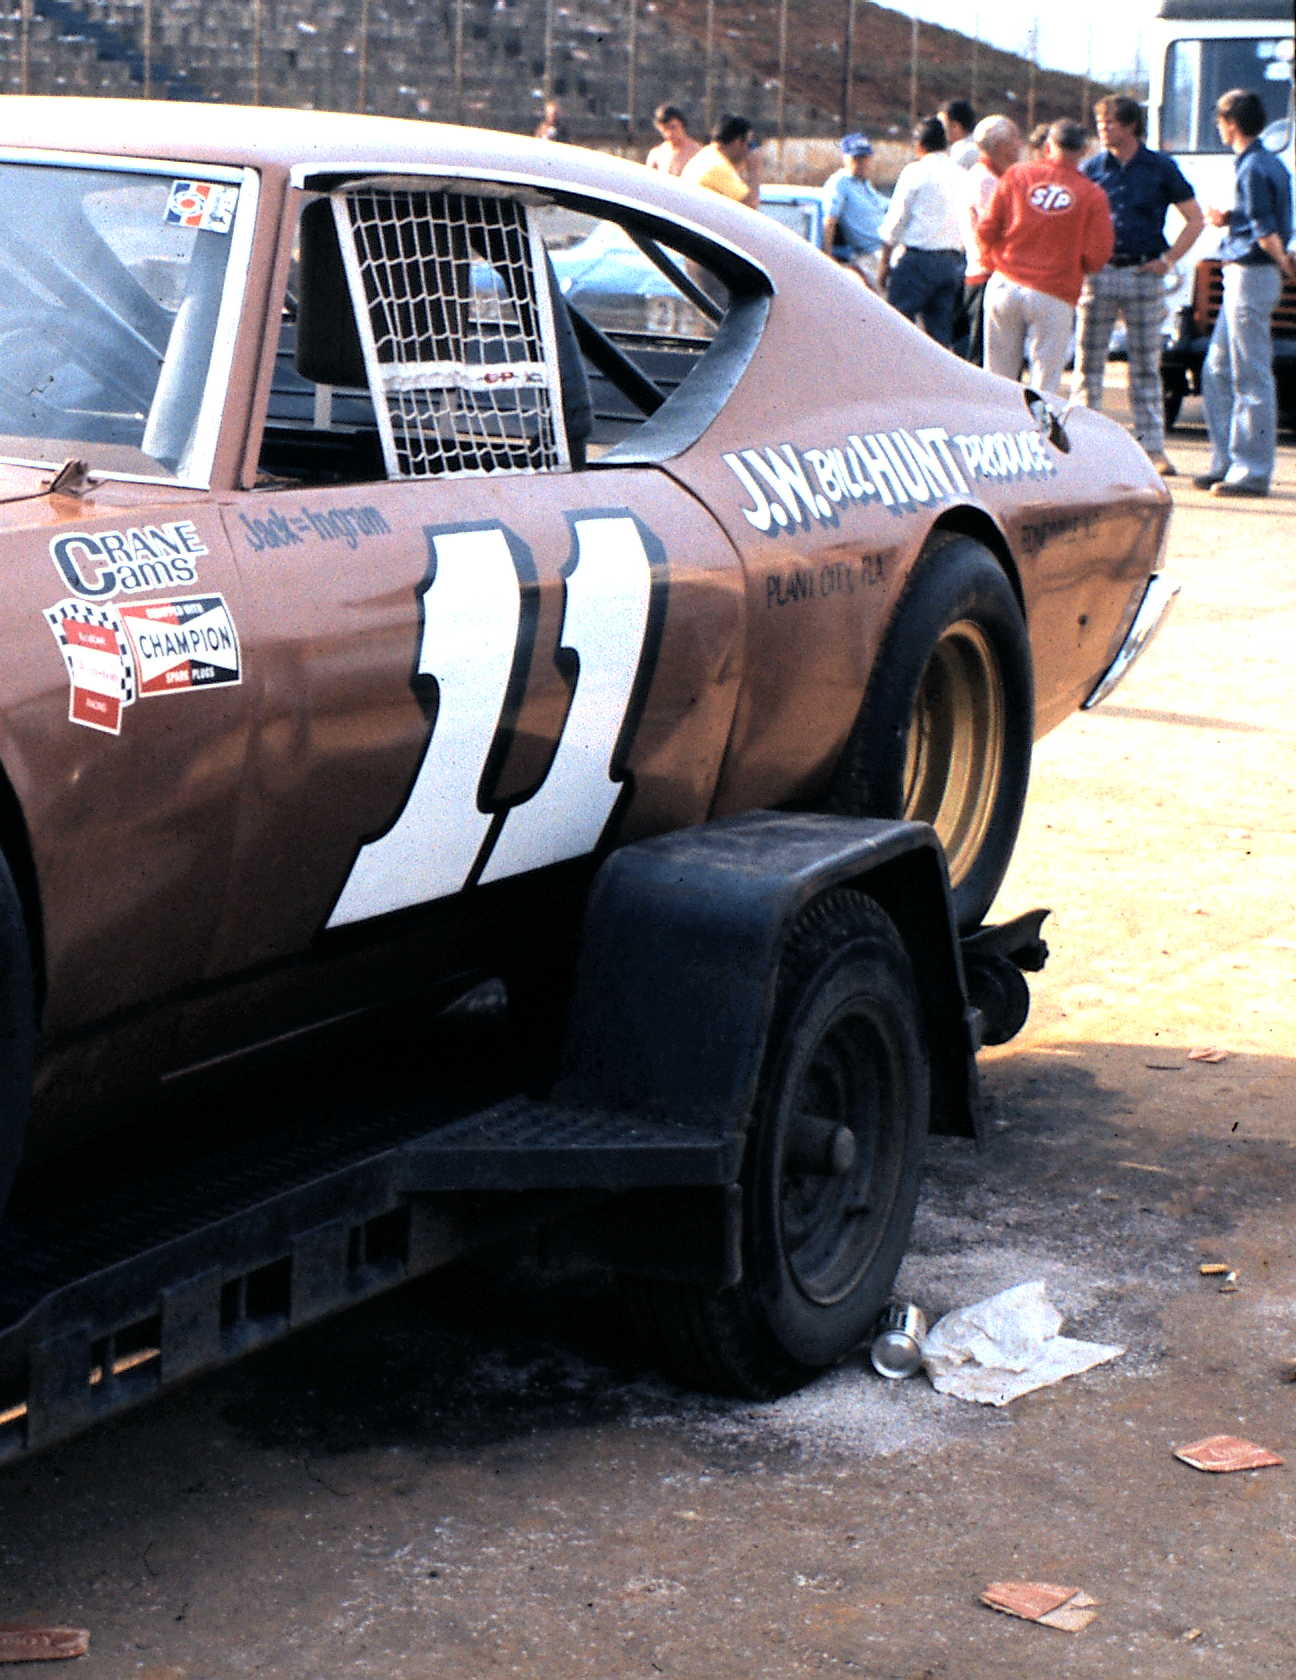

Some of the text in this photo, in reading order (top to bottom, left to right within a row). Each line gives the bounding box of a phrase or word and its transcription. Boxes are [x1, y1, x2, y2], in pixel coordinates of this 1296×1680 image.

[1030, 184, 1072, 210] STP
[847, 427, 970, 505] HUNT
[954, 430, 1053, 479] PRODUCE
[52, 522, 208, 597] CRANE
[138, 624, 232, 660] CHAMPION
[165, 666, 216, 684] SPARK PLUGS
[323, 510, 664, 930] 11
